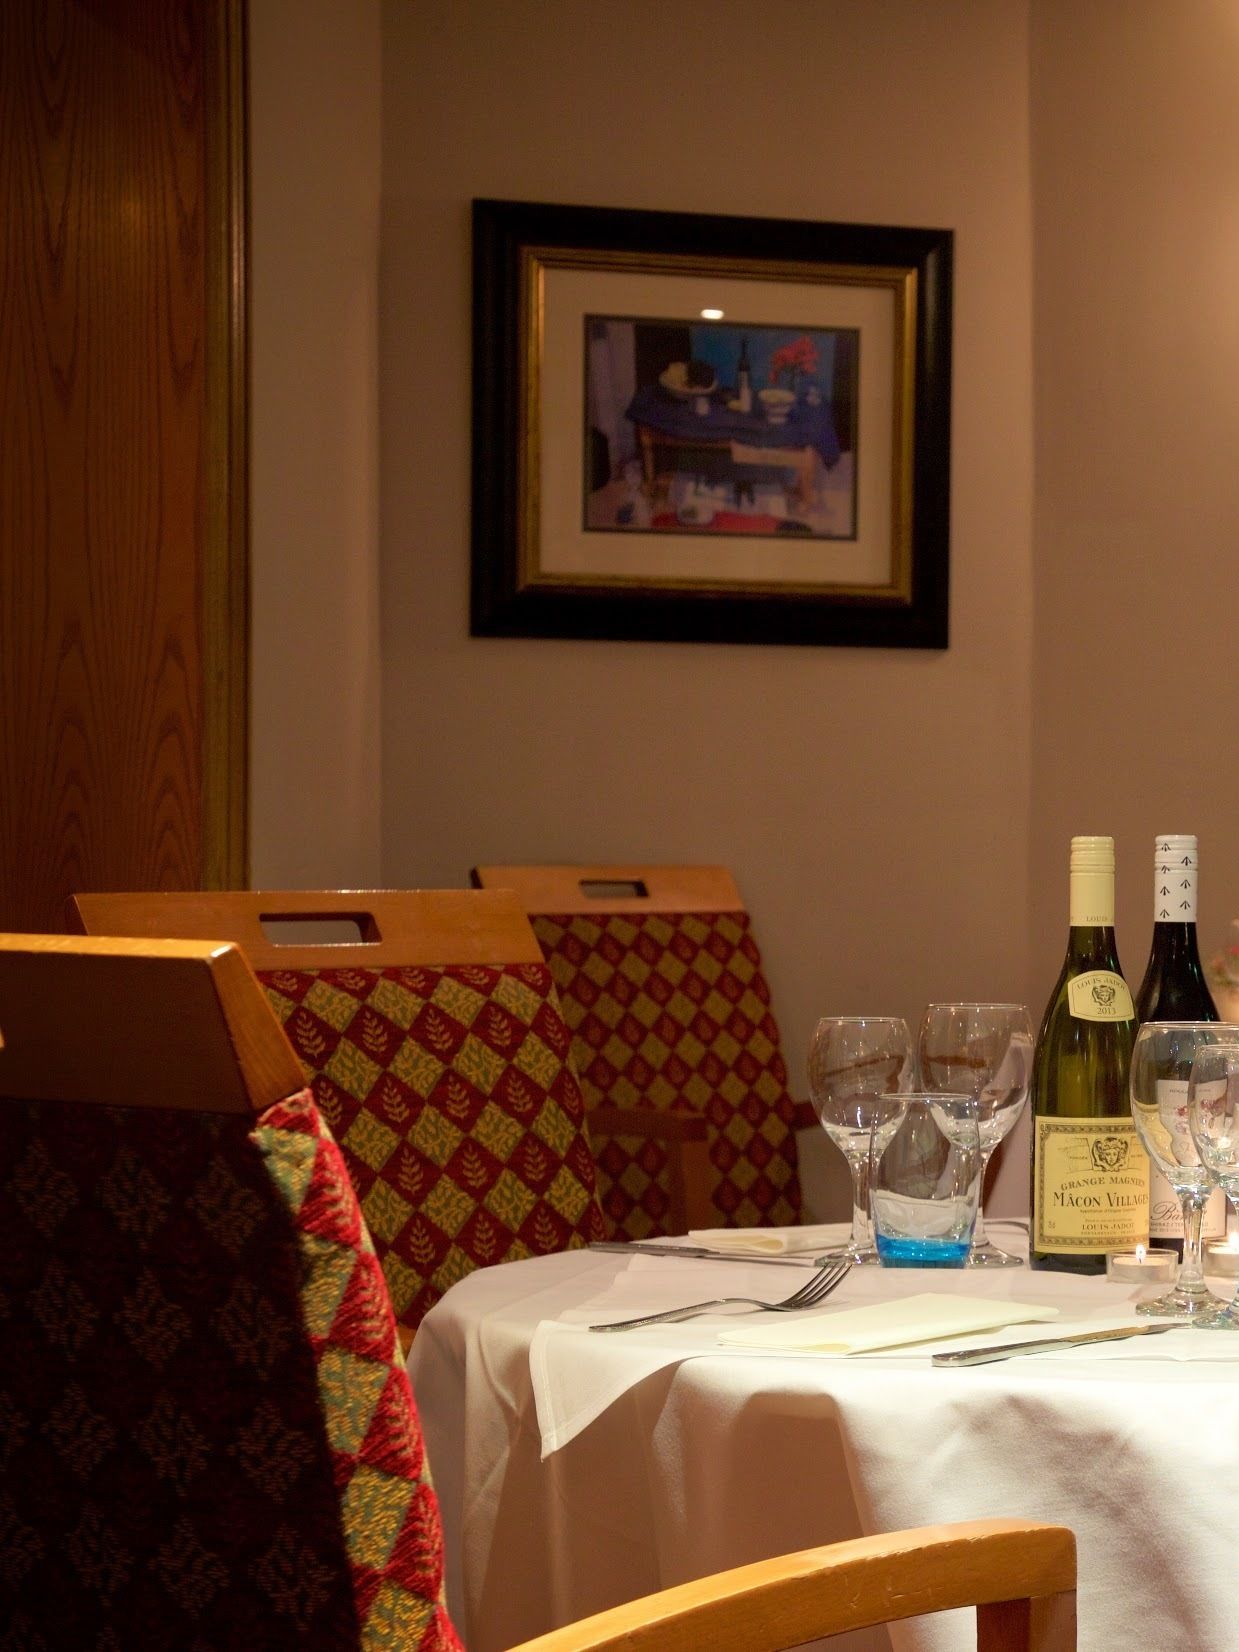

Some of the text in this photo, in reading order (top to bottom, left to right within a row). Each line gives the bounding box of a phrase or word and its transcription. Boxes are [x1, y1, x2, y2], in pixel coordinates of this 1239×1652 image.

[1076, 977, 1100, 991] LOUIS
[1061, 1177, 1105, 1191] GRANGE
[1053, 1191, 1101, 1207] MÂCON
[1082, 1222, 1134, 1231] LOUIS JADOT
